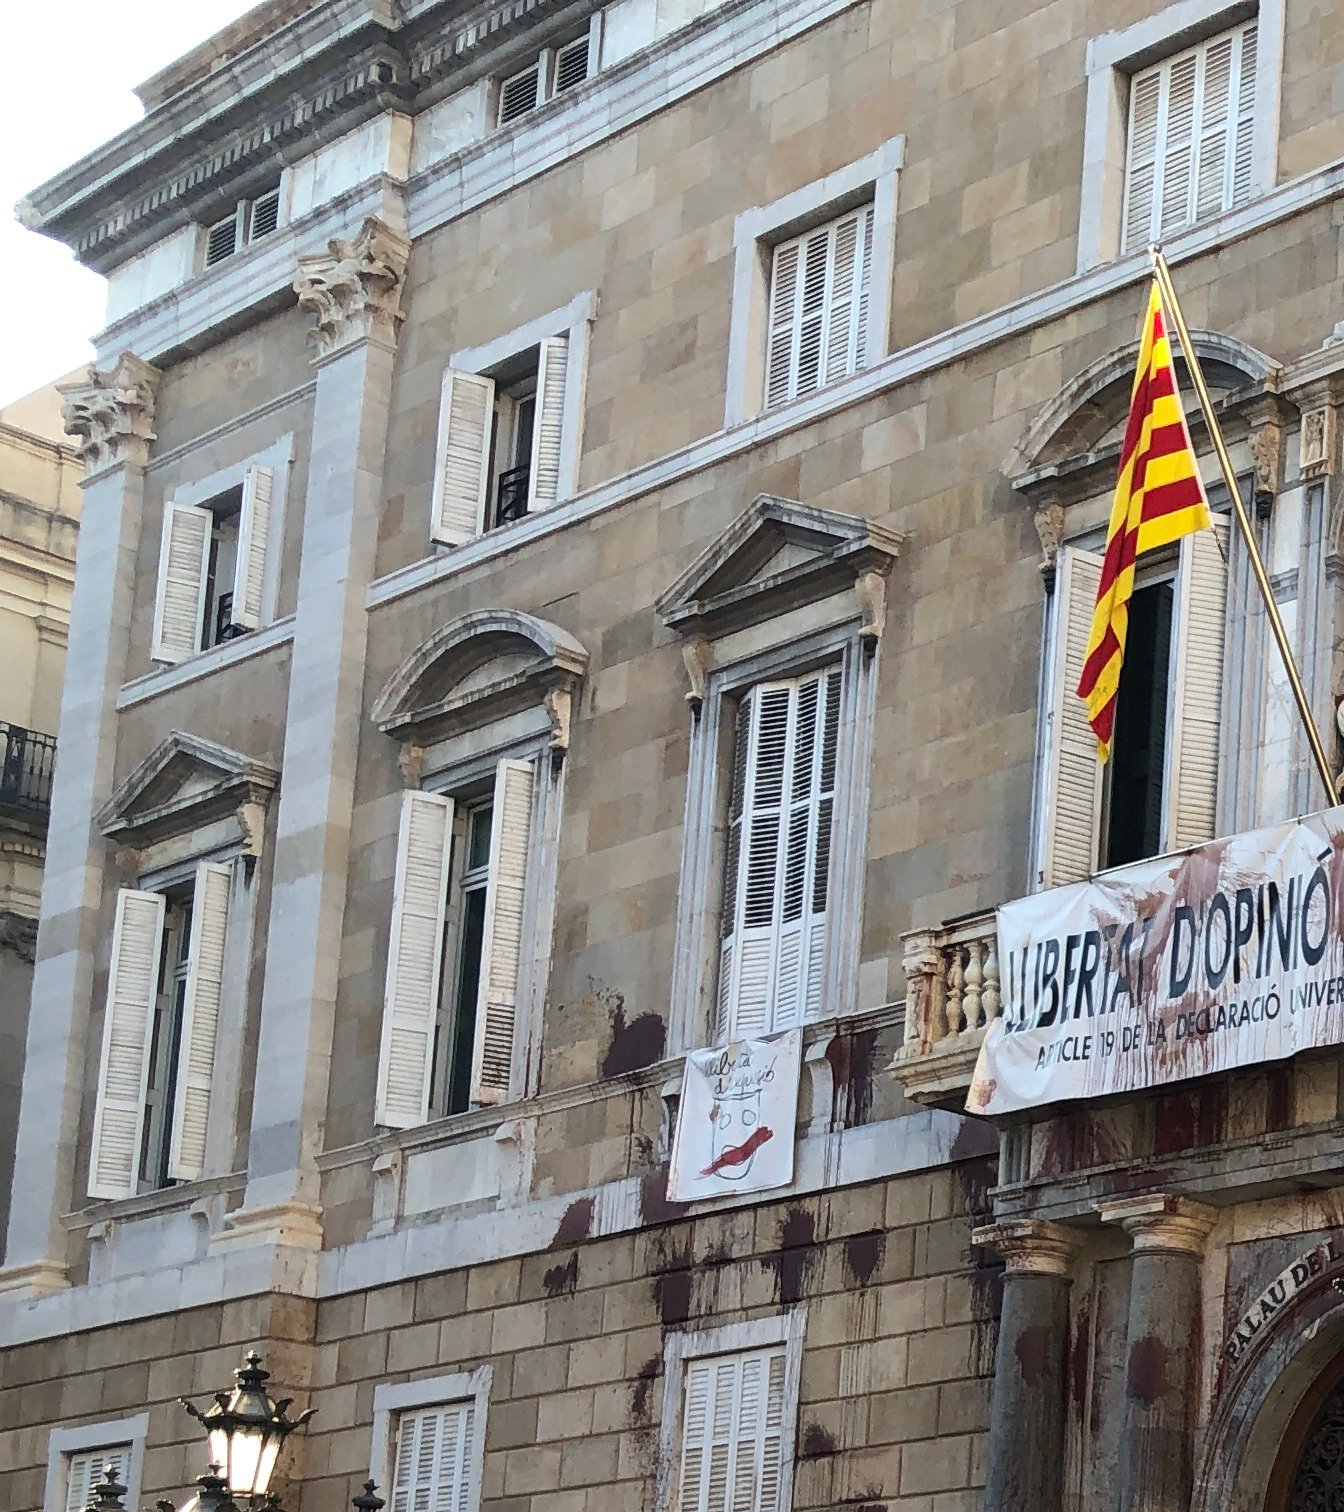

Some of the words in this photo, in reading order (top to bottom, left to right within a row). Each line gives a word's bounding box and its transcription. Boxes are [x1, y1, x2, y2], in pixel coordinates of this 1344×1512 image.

[1034, 1035, 1091, 1072] ARTICLE
[1101, 1031, 1115, 1058] 19
[1123, 1024, 1141, 1052] DE
[1148, 1020, 1167, 1046] LA
[1176, 984, 1280, 1041] DECLARACIÓ
[1225, 1279, 1286, 1364] PALAU
[1290, 1251, 1324, 1289] DE
